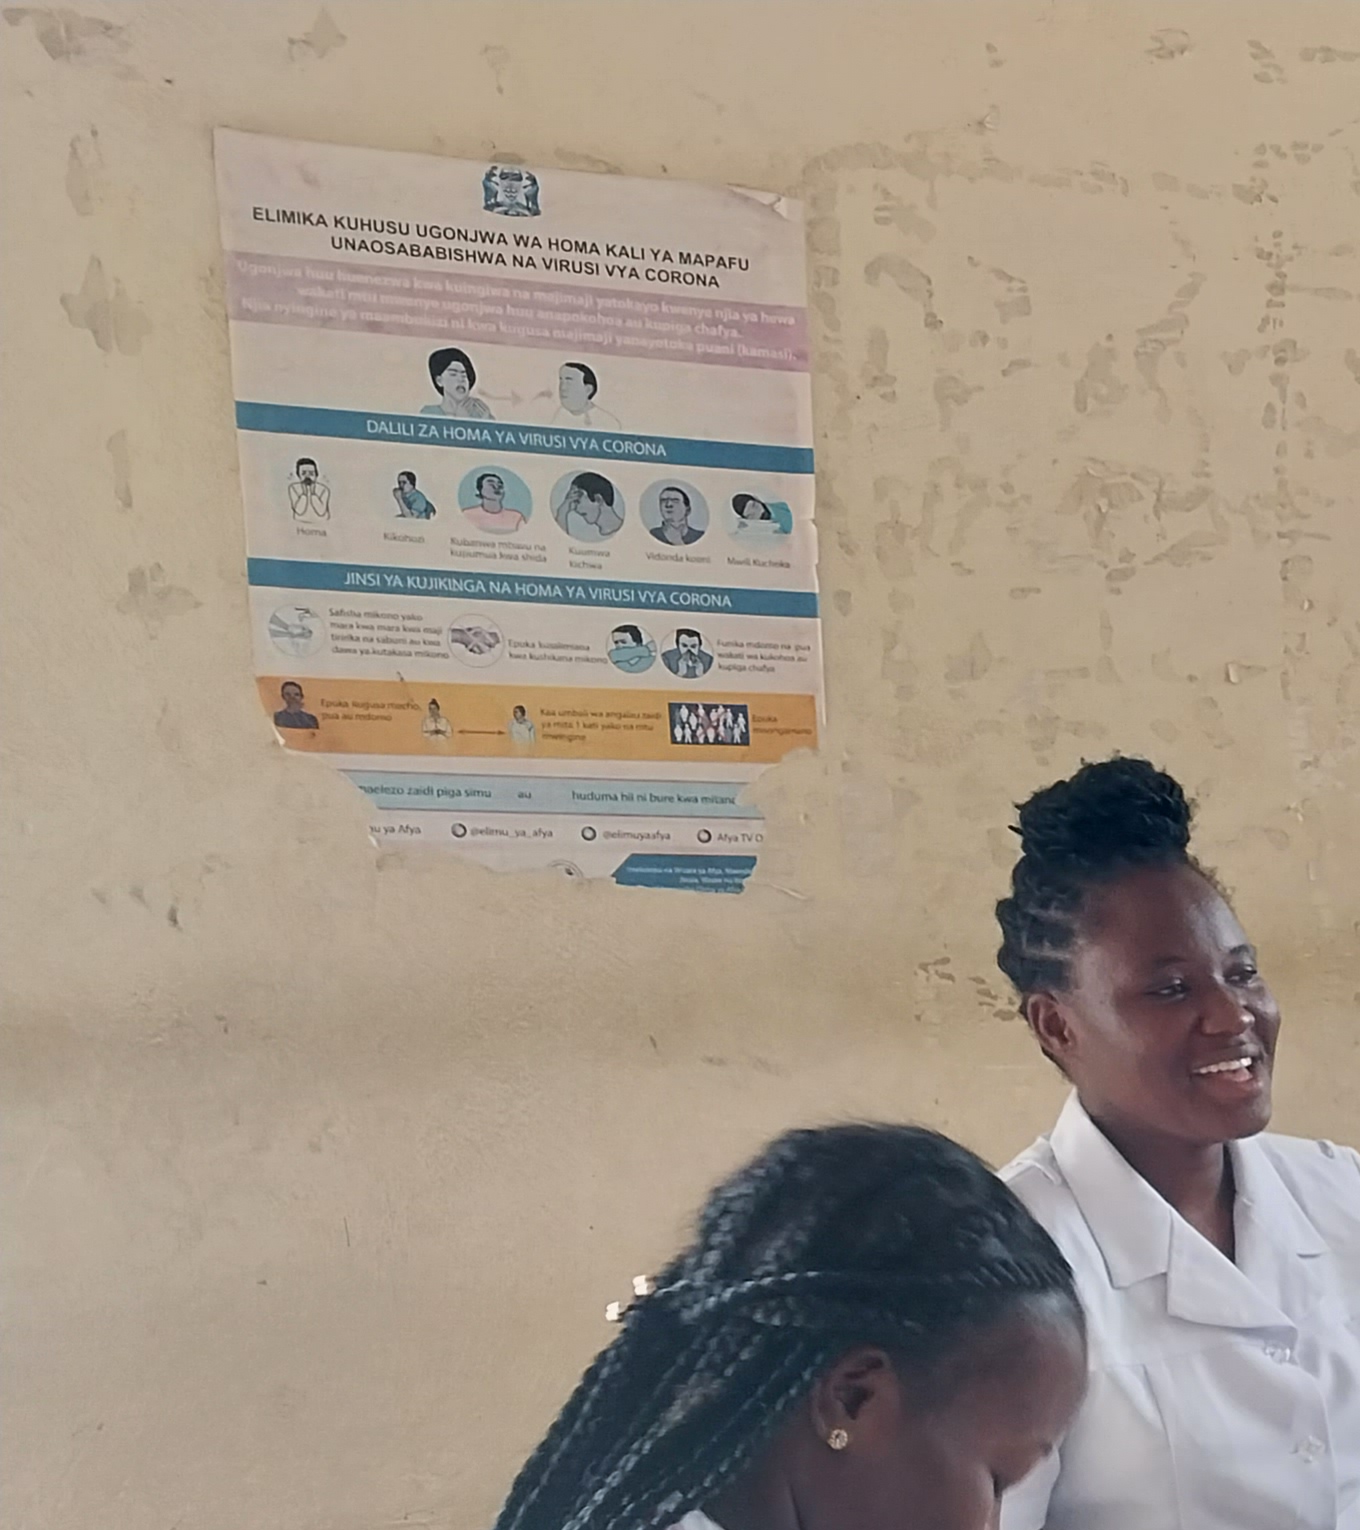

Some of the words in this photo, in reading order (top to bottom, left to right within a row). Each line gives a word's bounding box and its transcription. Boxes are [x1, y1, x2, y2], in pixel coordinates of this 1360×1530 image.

[253, 206, 328, 228] ELIMIKA
[334, 215, 409, 236] KUHUSU
[417, 223, 508, 247] UGONJWA
[513, 233, 542, 250] WA
[549, 237, 600, 256] HOMA
[606, 243, 645, 261] KALI
[650, 247, 673, 264] YA
[679, 250, 749, 271] MAPAFU
[237, 259, 302, 279] Ugonjwa
[331, 236, 507, 267] UNAOSABABISHWA
[513, 254, 537, 270] NA
[542, 257, 599, 276] VIRUSI
[605, 263, 640, 280] VYA
[645, 267, 720, 288] CORONA
[367, 420, 414, 437] DALILI
[419, 424, 439, 439] ZA
[443, 426, 492, 443] HOMA
[495, 430, 516, 445] YA
[519, 432, 566, 449] VIRUSI
[570, 437, 599, 452] VYA
[603, 439, 667, 457] CORONA
[297, 527, 327, 537] Homa
[345, 572, 380, 587] JINSI
[383, 574, 403, 589] YA
[408, 575, 486, 593] KUJIKINGA
[490, 580, 512, 595] NA
[515, 582, 562, 598] HOMA
[566, 585, 586, 599] YA
[589, 587, 634, 602] VIRUSI
[638, 590, 666, 604] VYA
[670, 592, 733, 608] CORONA
[407, 785, 434, 796] zaidi
[436, 786, 462, 799] piga
[464, 788, 492, 798] simu
[517, 791, 532, 799] au
[571, 790, 619, 802] huduma
[636, 793, 647, 802] ni
[649, 792, 675, 803] bure
[677, 793, 699, 804] kwa
[741, 833, 754, 842] TV
